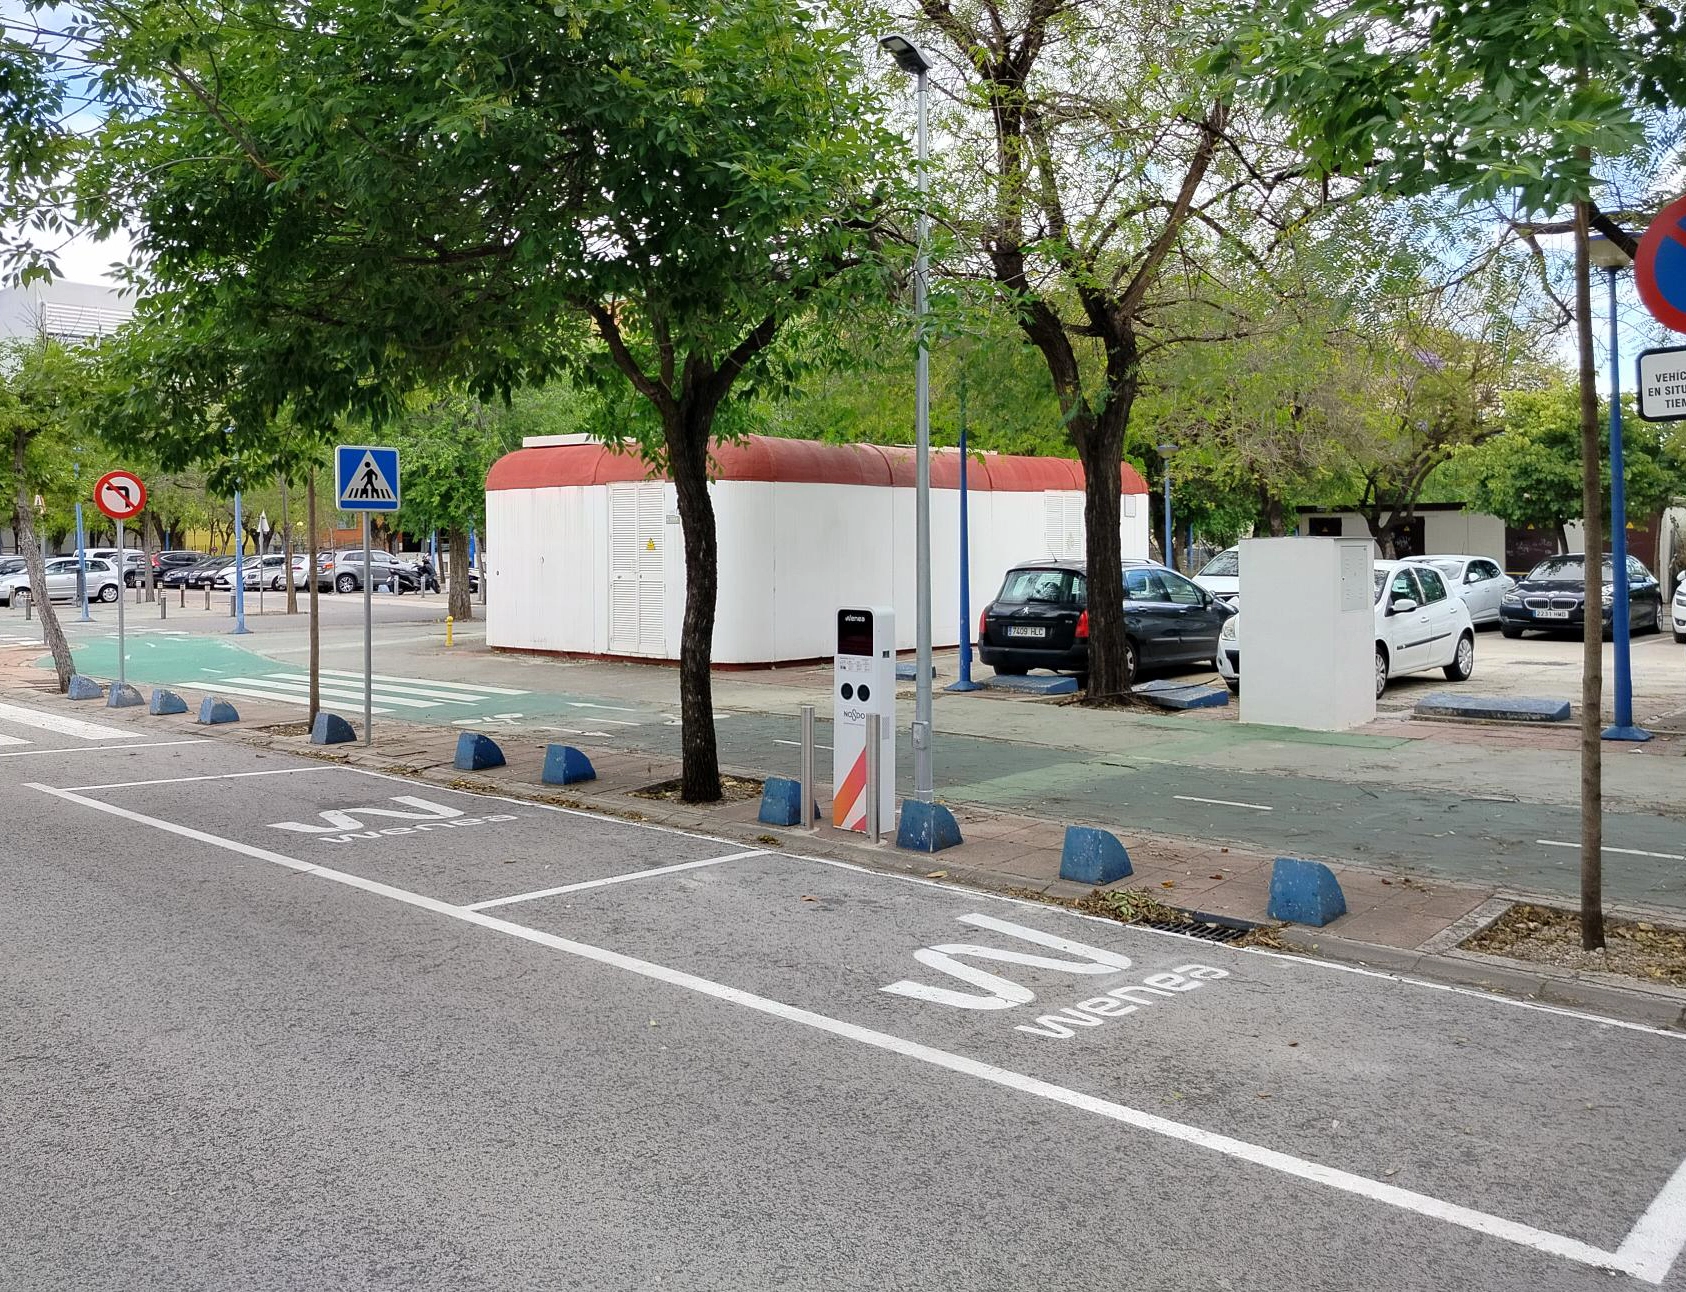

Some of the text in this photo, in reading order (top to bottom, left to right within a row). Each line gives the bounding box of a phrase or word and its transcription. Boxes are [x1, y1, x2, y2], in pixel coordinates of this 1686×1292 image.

[1648, 387, 1661, 397] EN
[318, 814, 518, 843] wenea
[1014, 964, 1230, 1039] wenea
